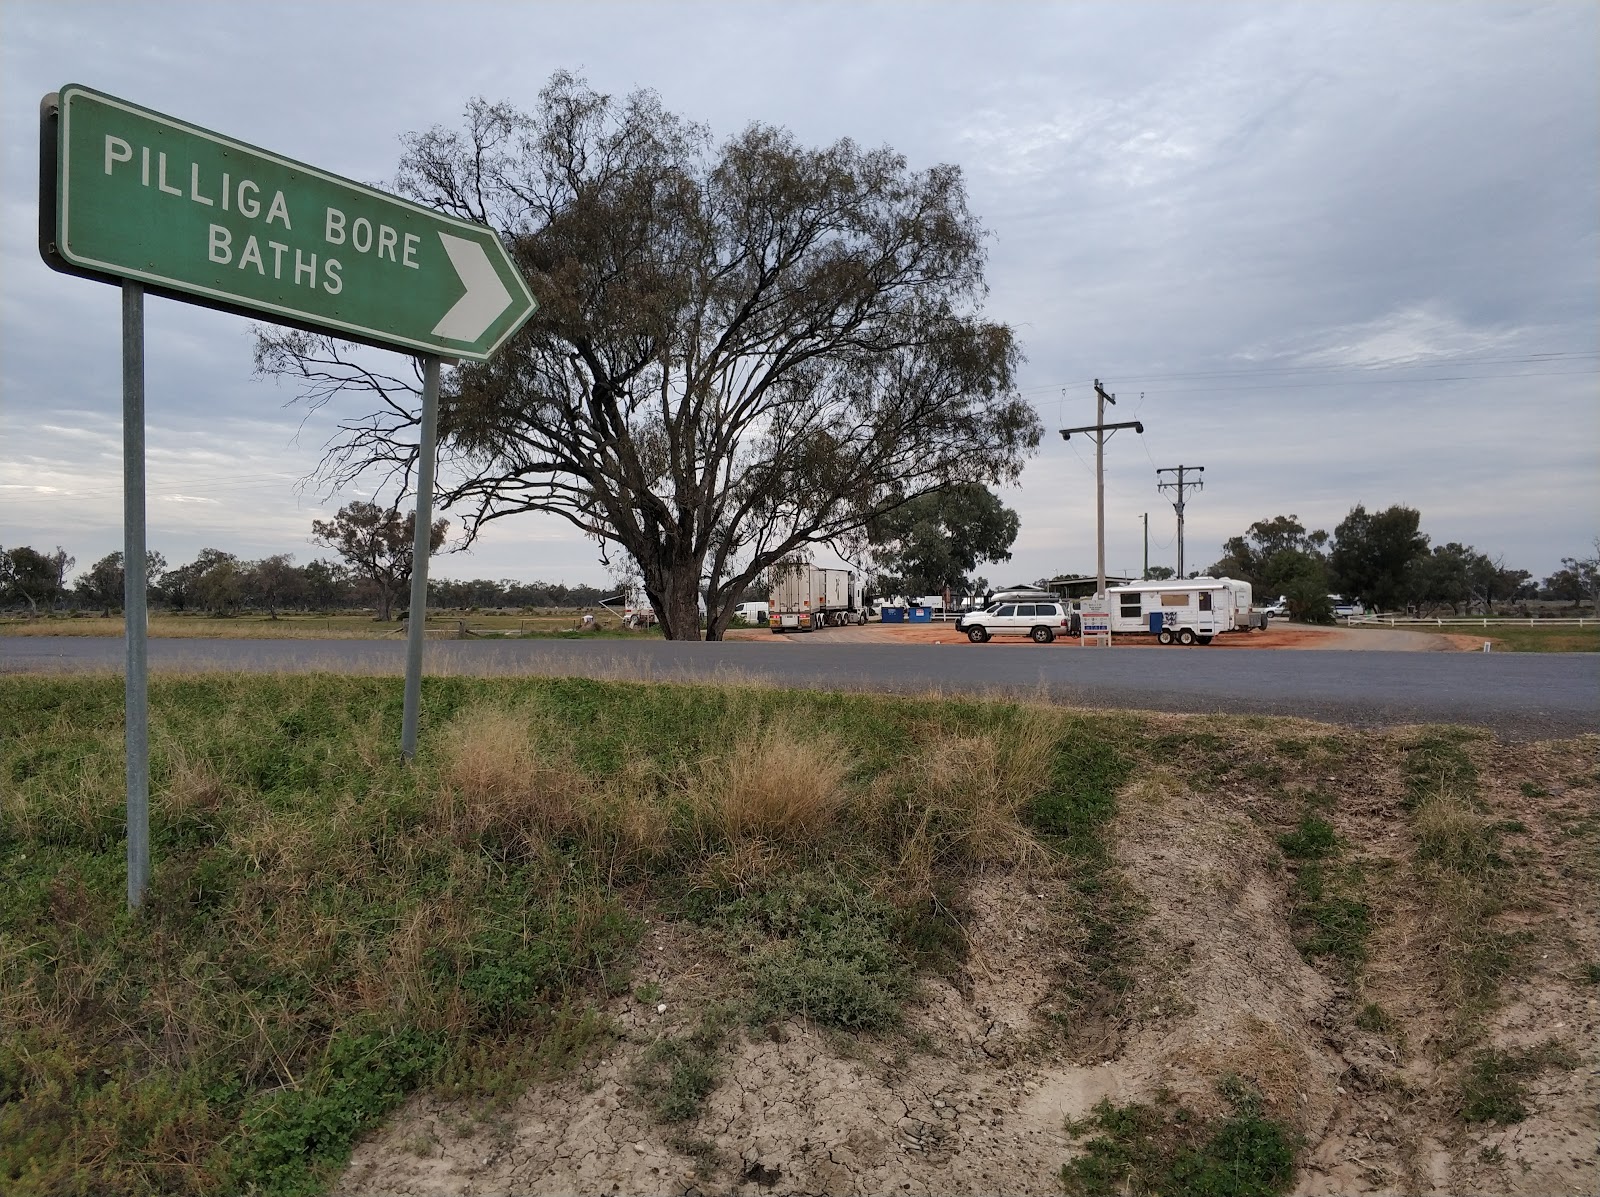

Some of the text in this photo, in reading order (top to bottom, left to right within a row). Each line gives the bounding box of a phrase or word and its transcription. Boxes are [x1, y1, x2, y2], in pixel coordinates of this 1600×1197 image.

[104, 134, 421, 270] PILLIGA BORE
[208, 223, 343, 295] BATHS
